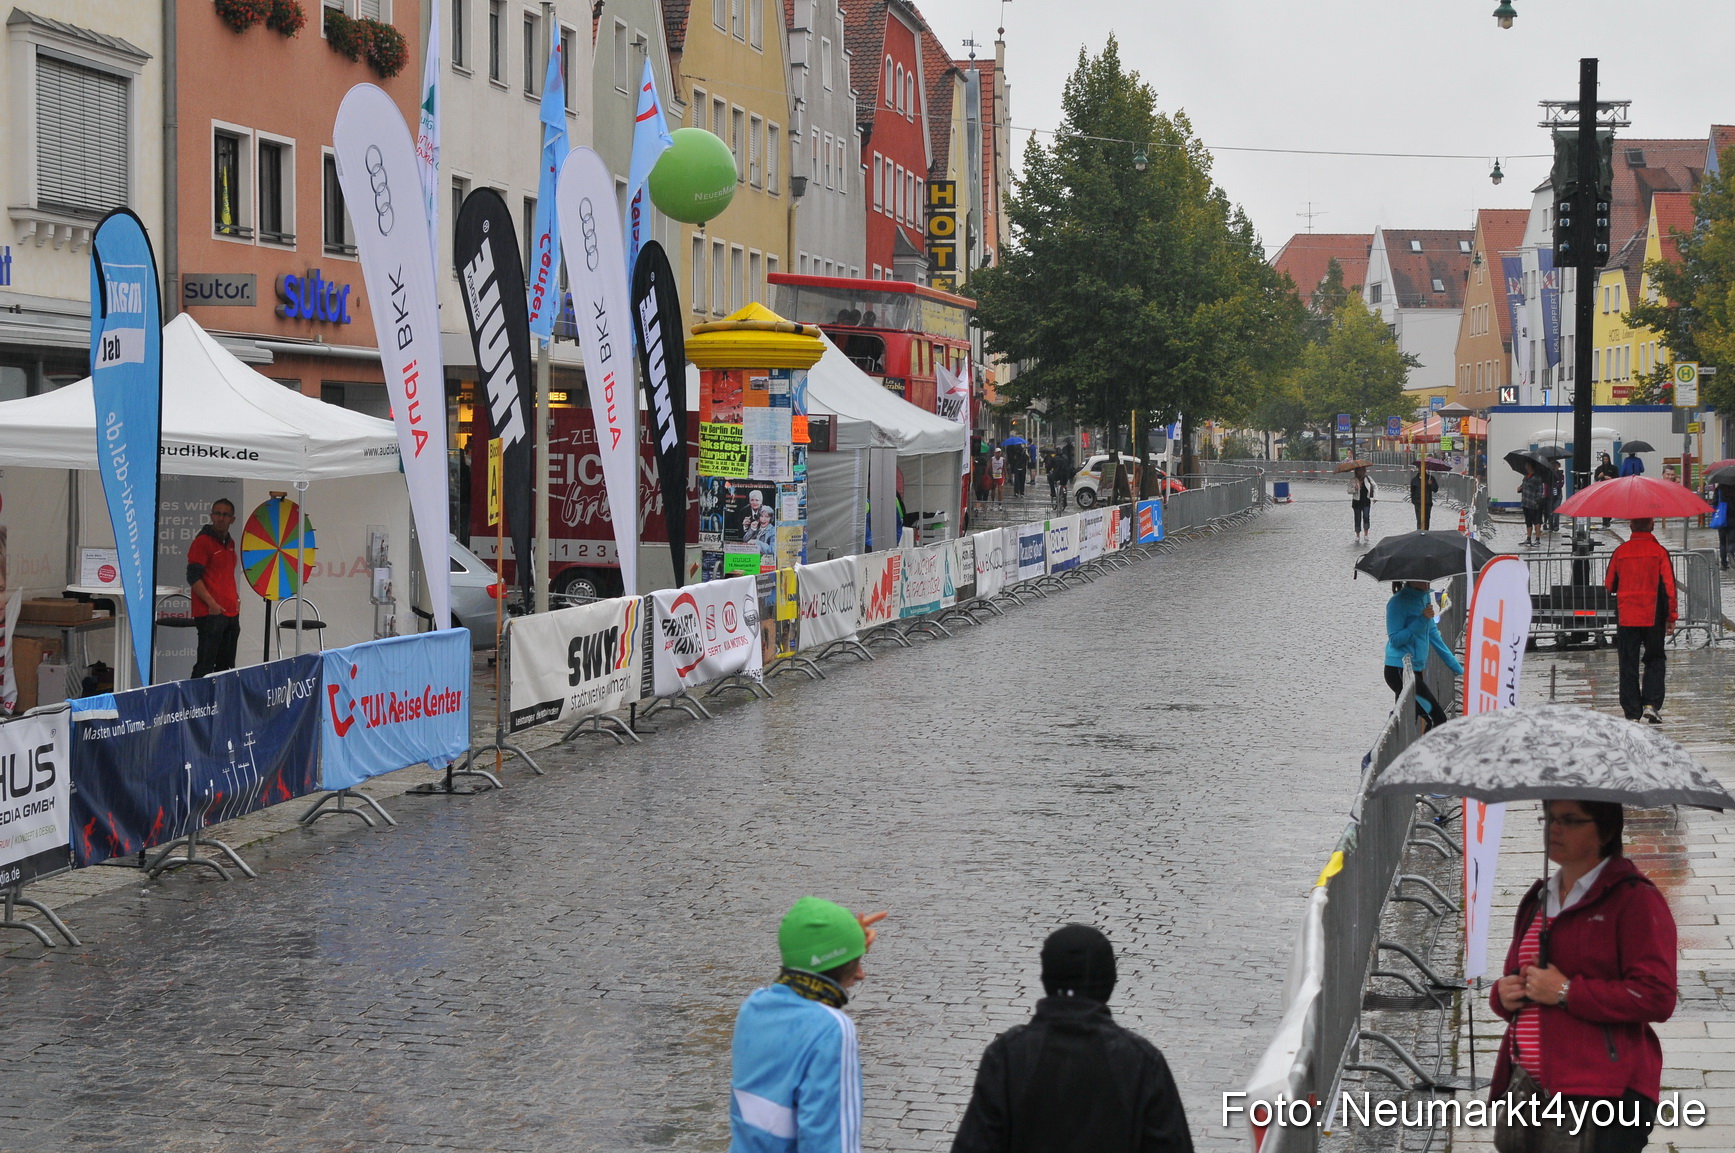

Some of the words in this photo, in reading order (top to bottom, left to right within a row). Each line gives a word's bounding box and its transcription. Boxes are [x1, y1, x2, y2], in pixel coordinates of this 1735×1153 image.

[930, 184, 955, 290] HOTE
[184, 279, 250, 300] sutor.
[284, 268, 351, 325] sutor.
[1550, 292, 1560, 336] RUPPERT
[1681, 369, 1690, 378] H
[709, 425, 728, 434] Berlin
[730, 426, 743, 436] Clu
[160, 444, 259, 461] audibkk.de
[490, 464, 498, 506] A
[820, 589, 839, 616] BKK
[662, 613, 693, 637] ERHART
[724, 608, 736, 627] KIA
[361, 692, 387, 729] TUI
[83, 723, 111, 741] Masten
[112, 721, 126, 737] und
[126, 719, 145, 733] Türme
[153, 716, 163, 728] sind
[23, 796, 55, 818] GMBH
[39, 823, 56, 837] DESIGN
